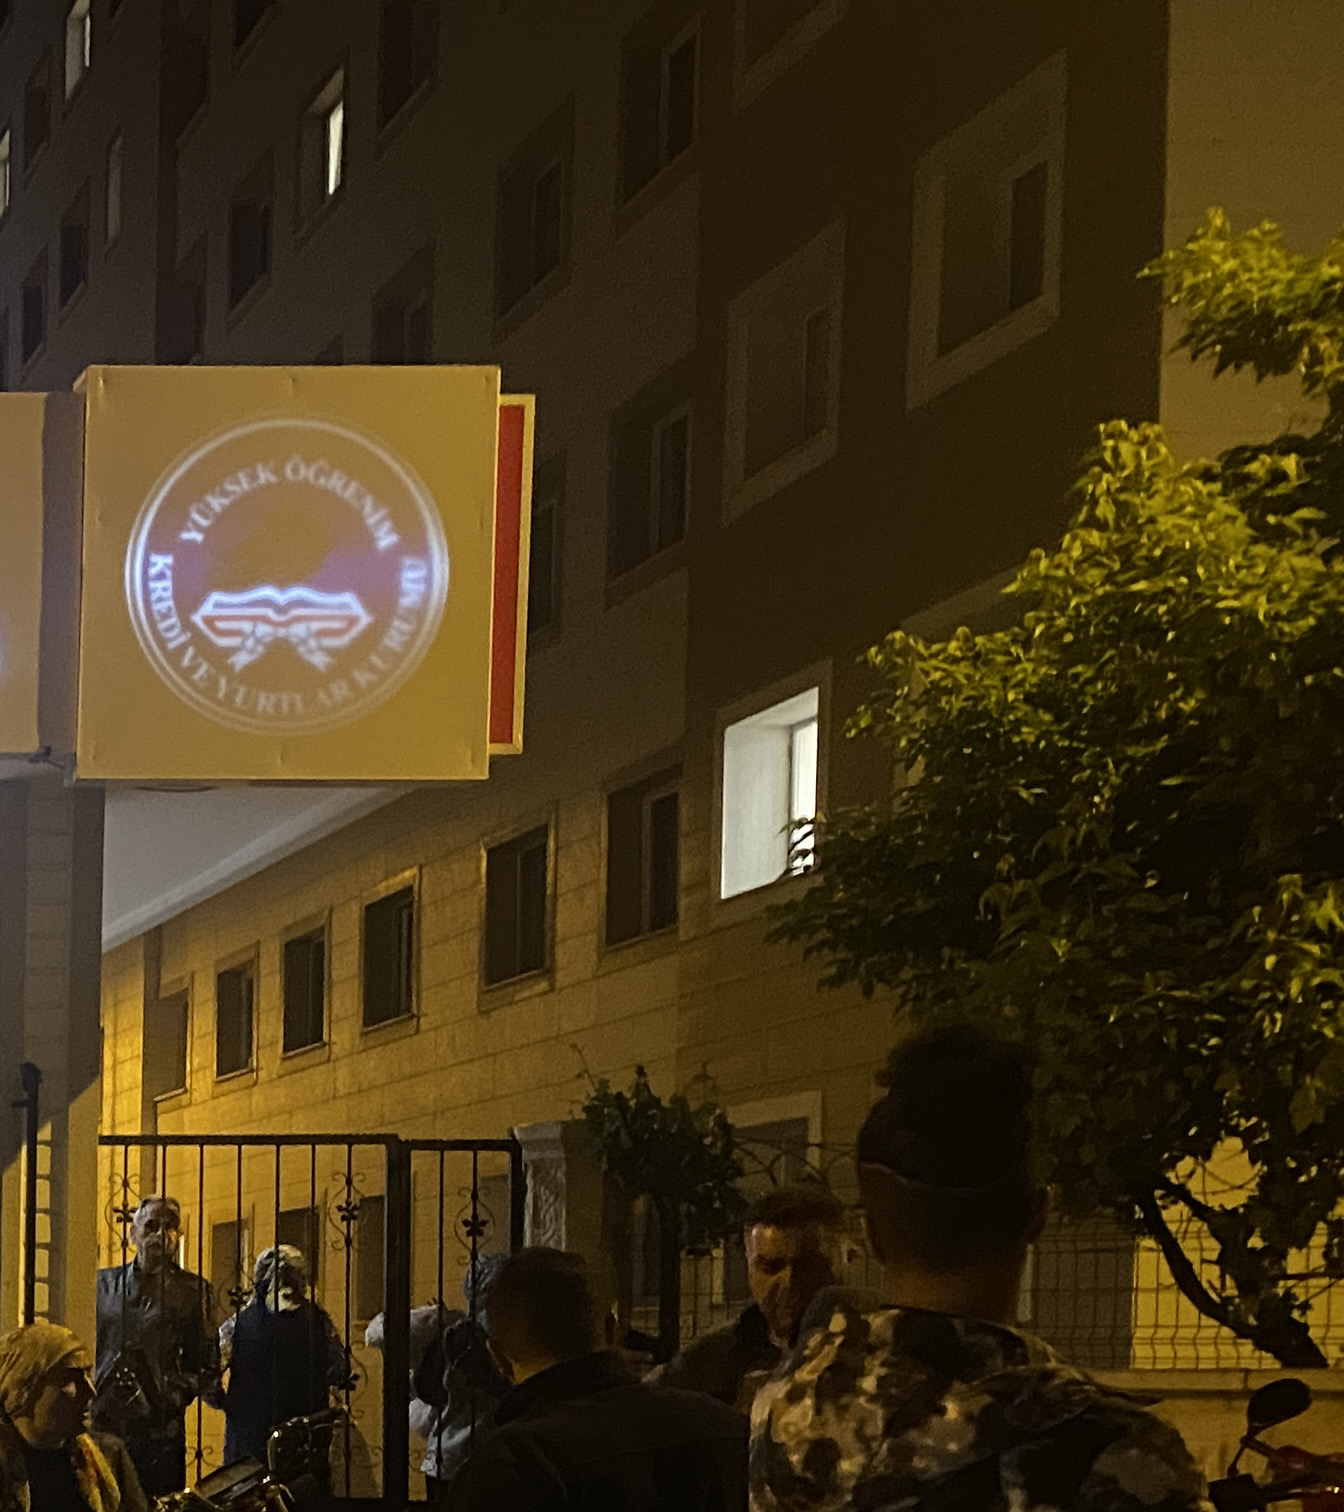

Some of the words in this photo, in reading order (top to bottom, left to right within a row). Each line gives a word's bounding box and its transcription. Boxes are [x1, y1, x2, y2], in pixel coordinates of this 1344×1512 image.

[178, 463, 281, 545] YÜKSEK
[283, 454, 402, 552] ÖĞRENİM
[147, 552, 193, 652] KREDİ
[179, 648, 212, 687] VE
